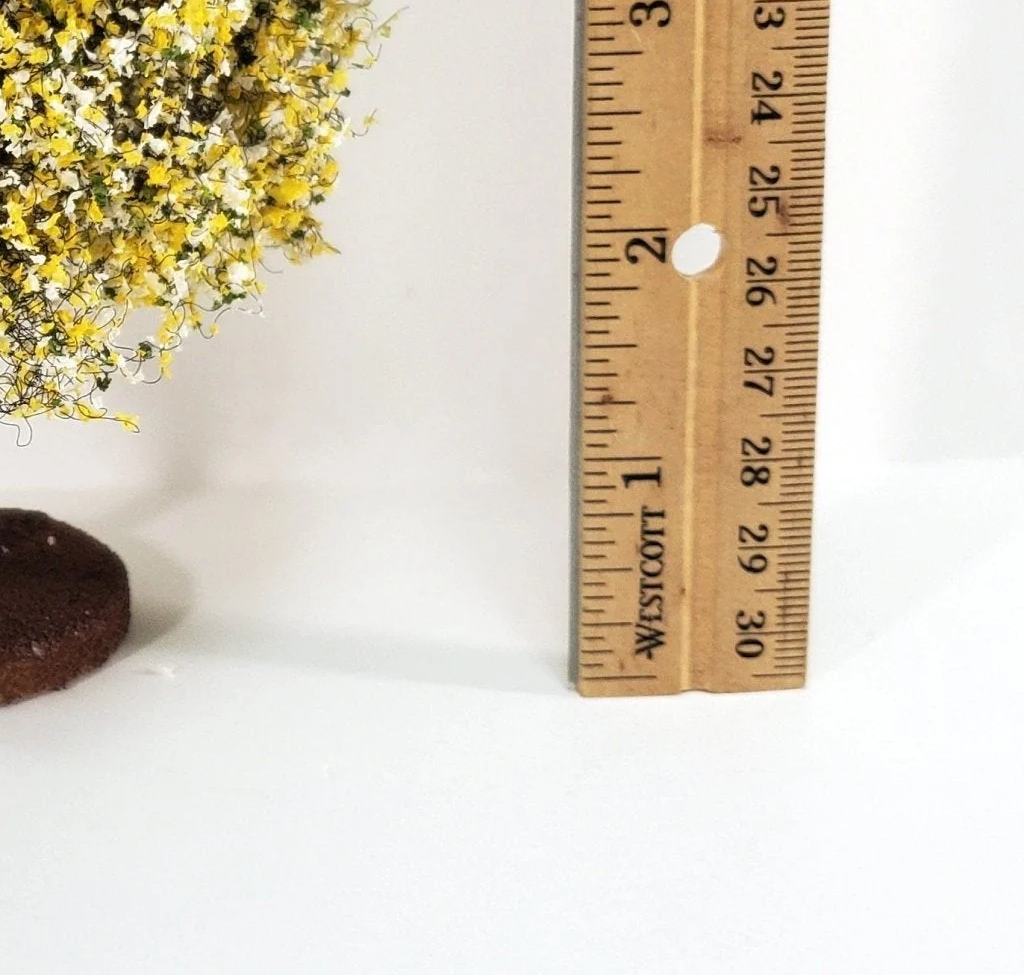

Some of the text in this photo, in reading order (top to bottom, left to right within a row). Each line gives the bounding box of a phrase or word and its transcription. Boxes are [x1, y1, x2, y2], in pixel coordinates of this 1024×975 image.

[629, 0, 671, 27] 3
[751, 71, 783, 125] 24
[748, 165, 781, 219] 25
[625, 235, 667, 264] 2
[745, 256, 777, 306] 26
[743, 347, 775, 397] 27
[621, 466, 662, 489] 1
[740, 437, 772, 487] 28
[737, 524, 769, 574] 29
[634, 506, 666, 659] WESTCOTT
[735, 609, 766, 658] 30
